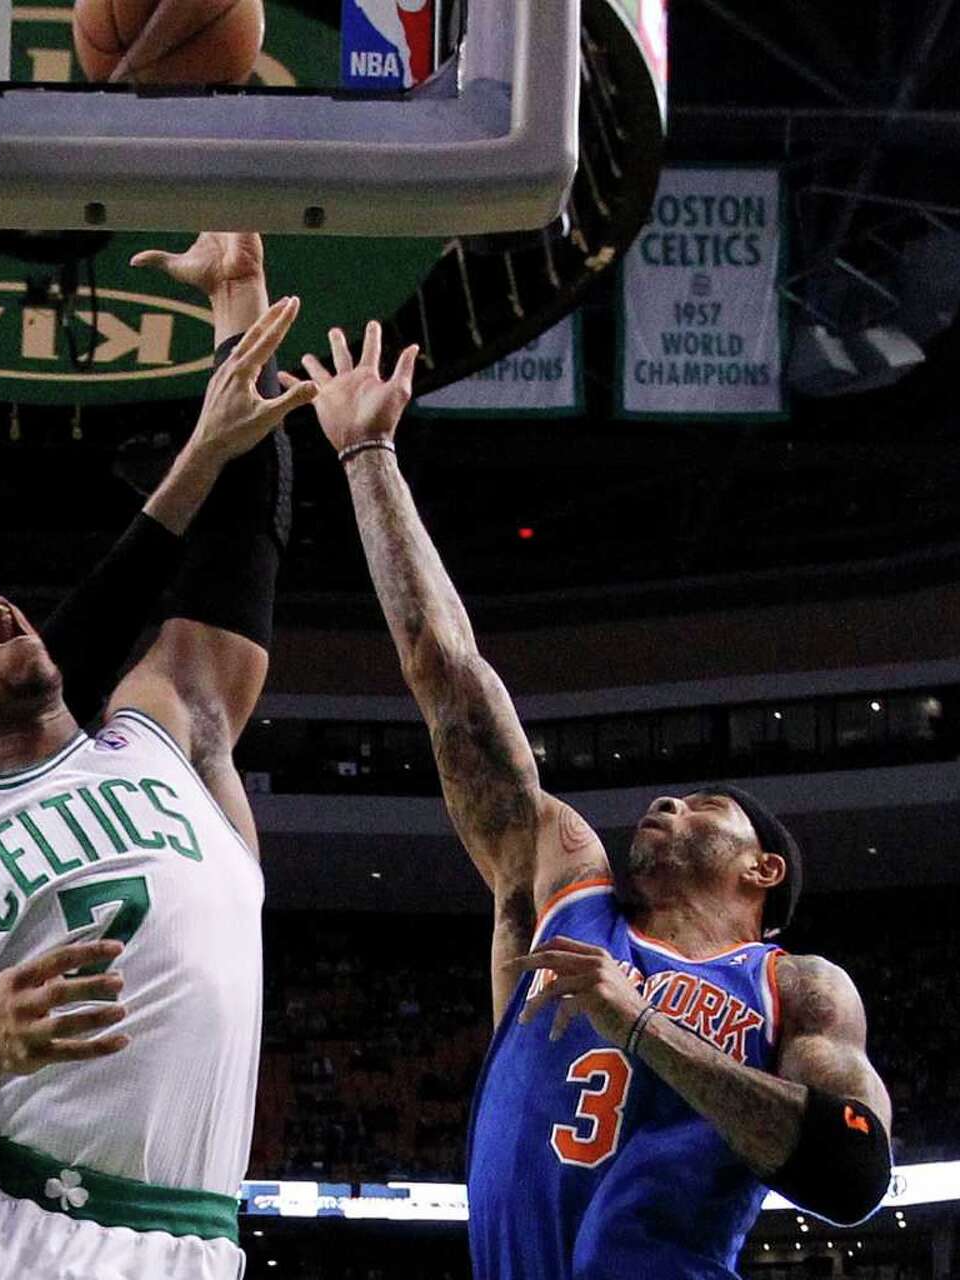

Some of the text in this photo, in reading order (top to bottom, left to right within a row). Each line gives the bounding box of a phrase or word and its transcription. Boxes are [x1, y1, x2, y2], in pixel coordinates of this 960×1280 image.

[350, 51, 399, 77] NBA
[653, 195, 765, 228] OSTON
[641, 232, 761, 267] CELTICS
[674, 302, 722, 326] 1957
[660, 331, 743, 358] WORLD
[634, 359, 771, 387] CHAMPIONS
[57, 876, 151, 979] 7
[550, 1047, 633, 1169] 3
